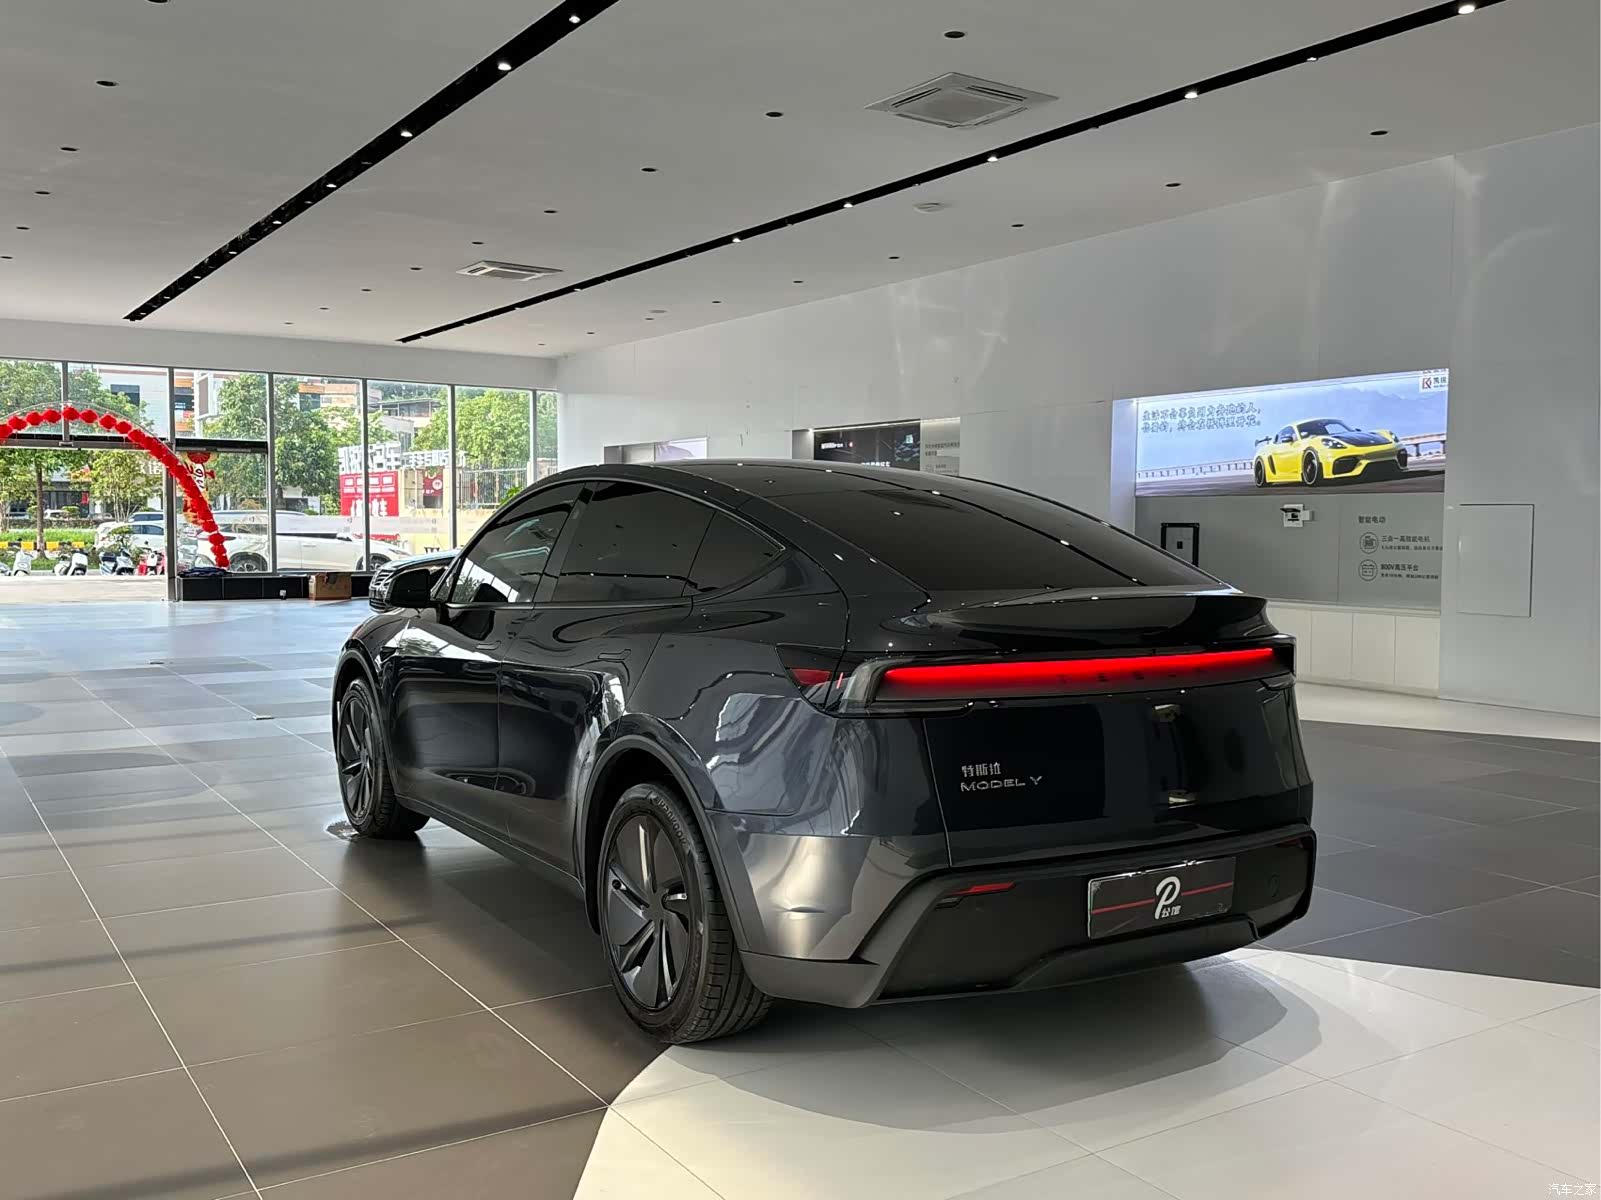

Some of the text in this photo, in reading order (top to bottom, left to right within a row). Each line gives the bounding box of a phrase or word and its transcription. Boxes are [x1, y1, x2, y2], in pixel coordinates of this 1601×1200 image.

[961, 762, 1001, 778] 特斯拉
[960, 775, 1043, 792] MODEL Y
[1161, 905, 1182, 918] 公馆
